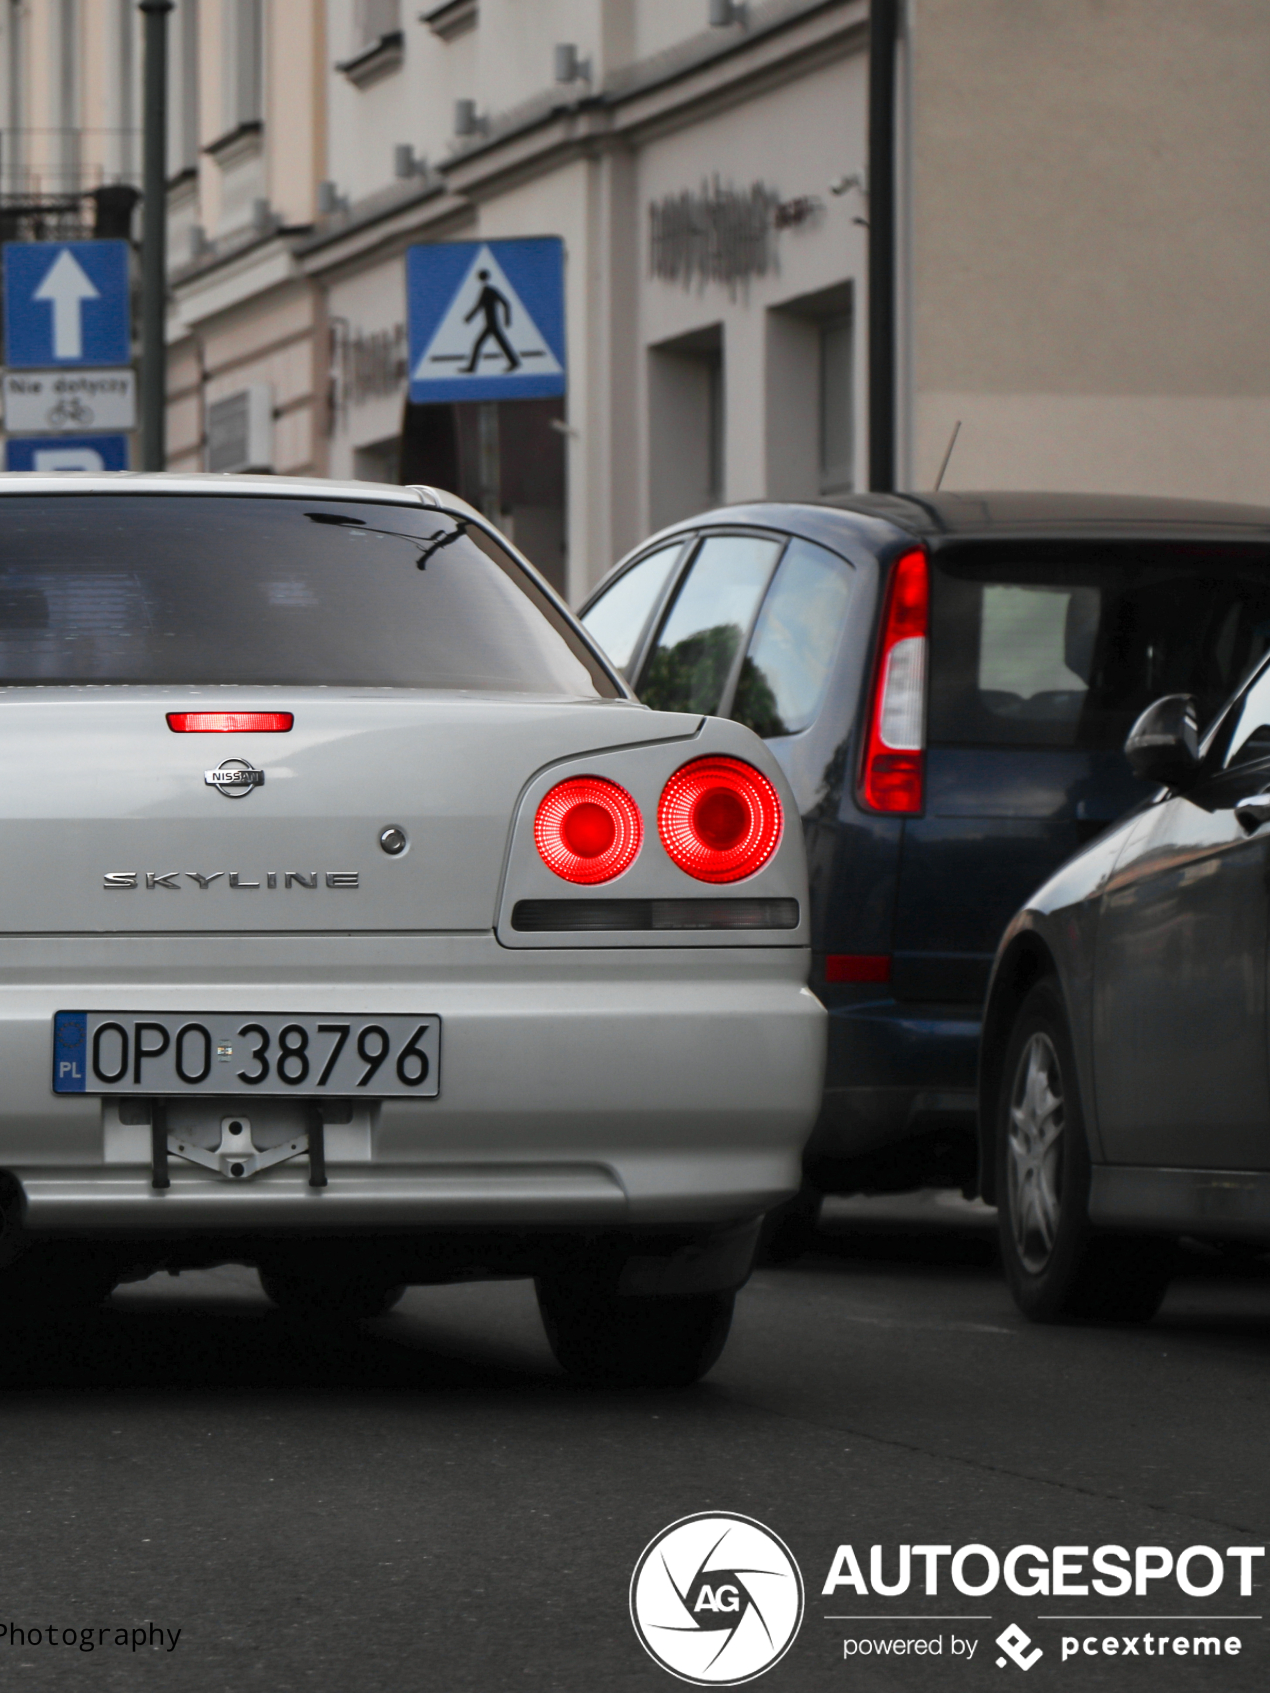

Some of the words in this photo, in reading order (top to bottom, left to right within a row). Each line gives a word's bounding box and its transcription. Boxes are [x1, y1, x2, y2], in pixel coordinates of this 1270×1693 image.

[9, 378, 42, 394] Nie
[53, 376, 129, 396] dotyczy
[212, 771, 260, 783] NISSAN
[103, 871, 360, 890] SKYLINE
[92, 1021, 212, 1085] OPO
[236, 1023, 431, 1087] 38796
[58, 1061, 82, 1079] PL
